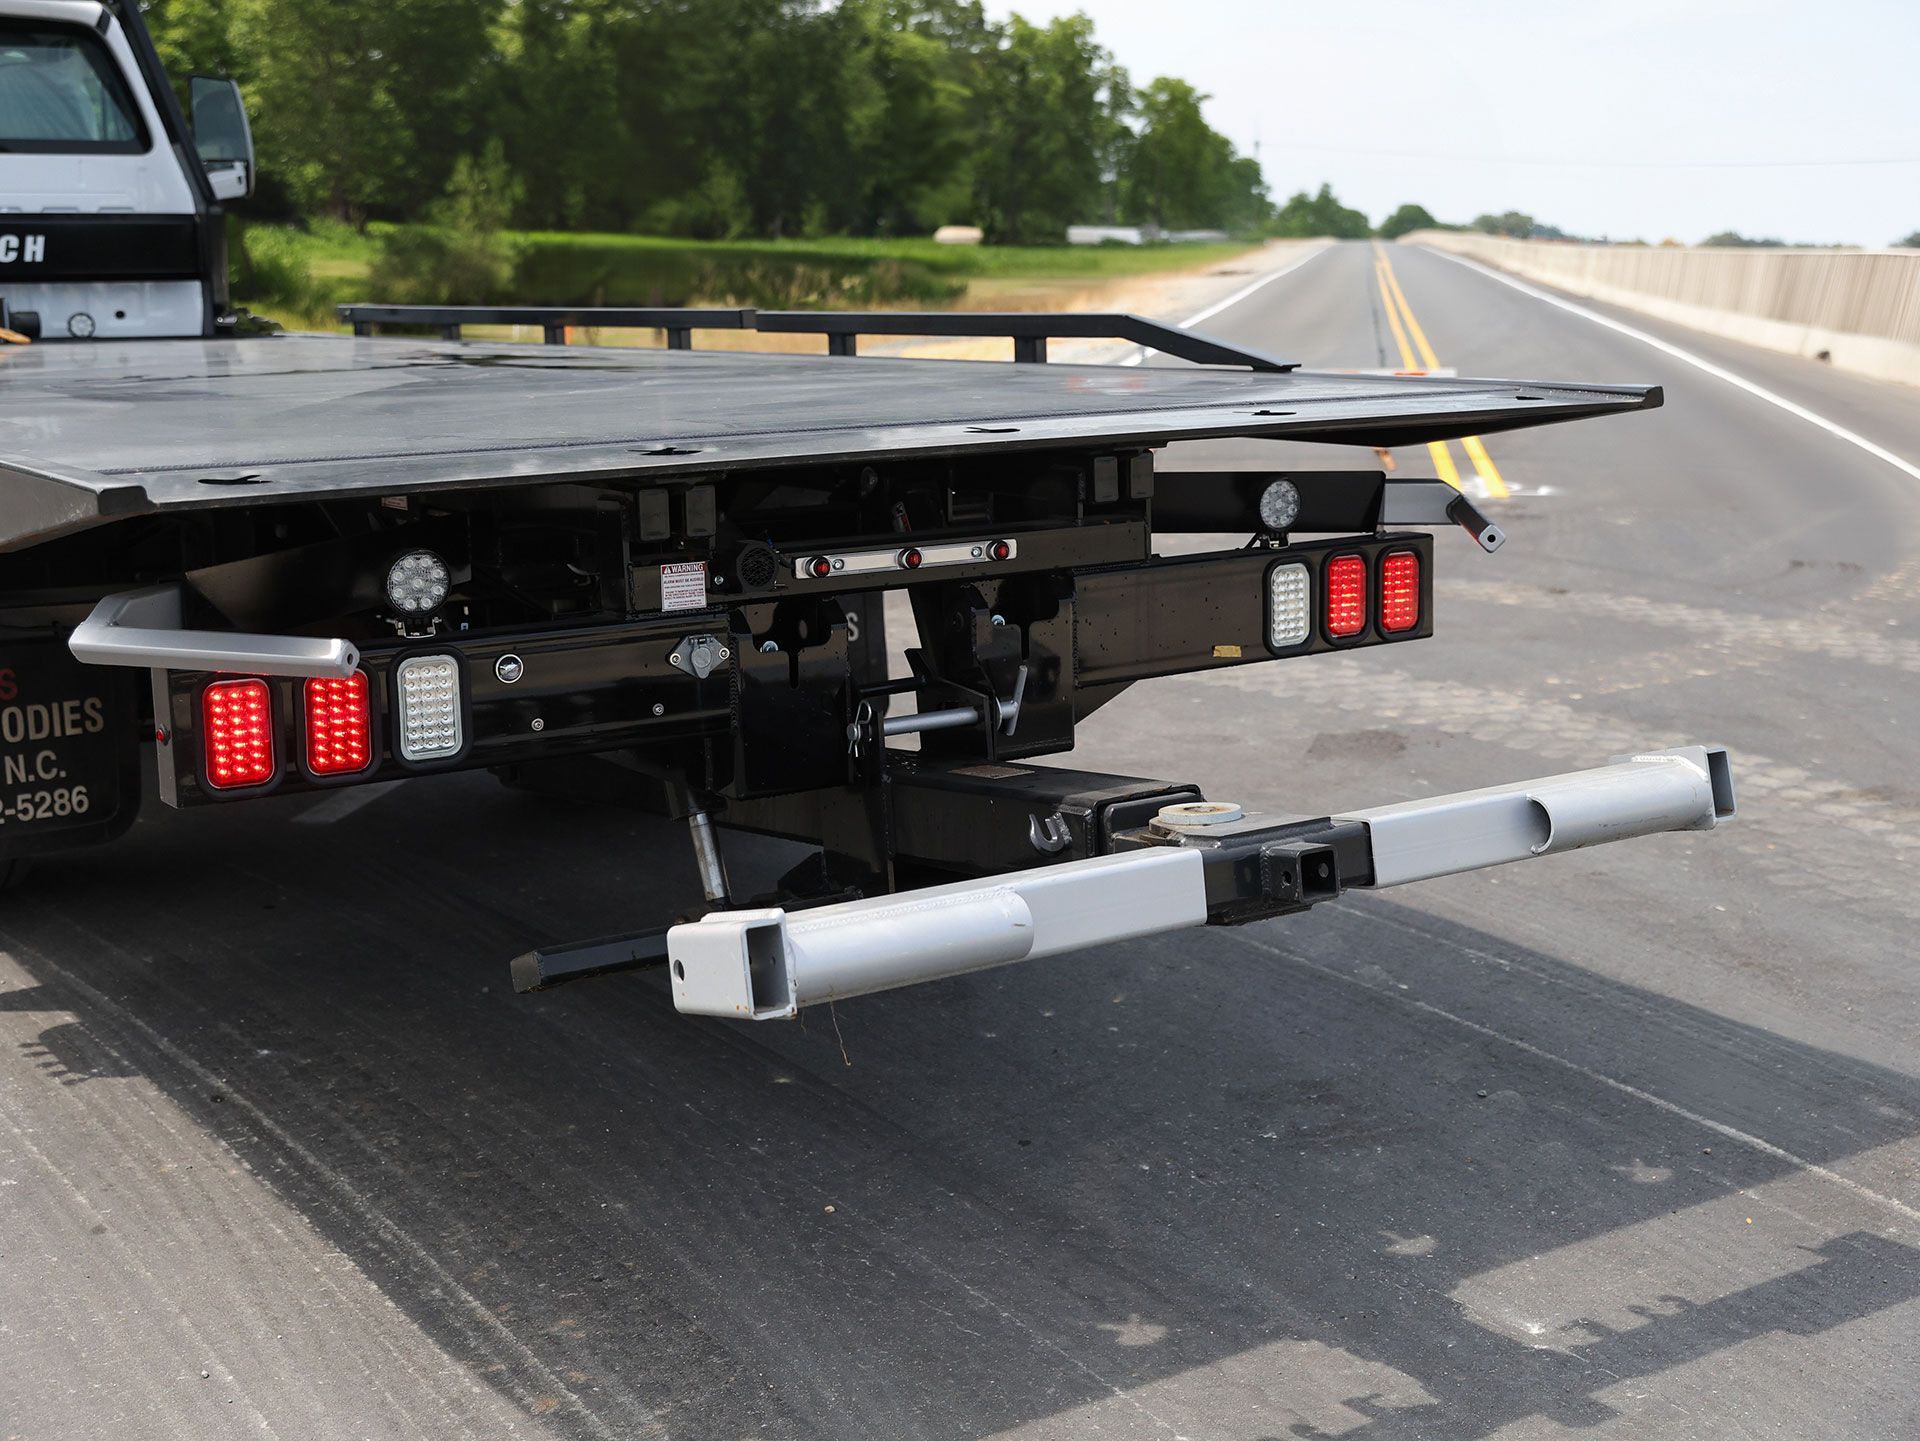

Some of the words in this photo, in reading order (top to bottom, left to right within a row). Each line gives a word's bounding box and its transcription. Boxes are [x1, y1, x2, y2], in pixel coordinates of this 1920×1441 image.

[0, 234, 46, 263] CH
[672, 563, 703, 573] WARNING
[846, 612, 859, 641] S
[1, 697, 105, 743] ODIES
[4, 750, 67, 785] N.C.
